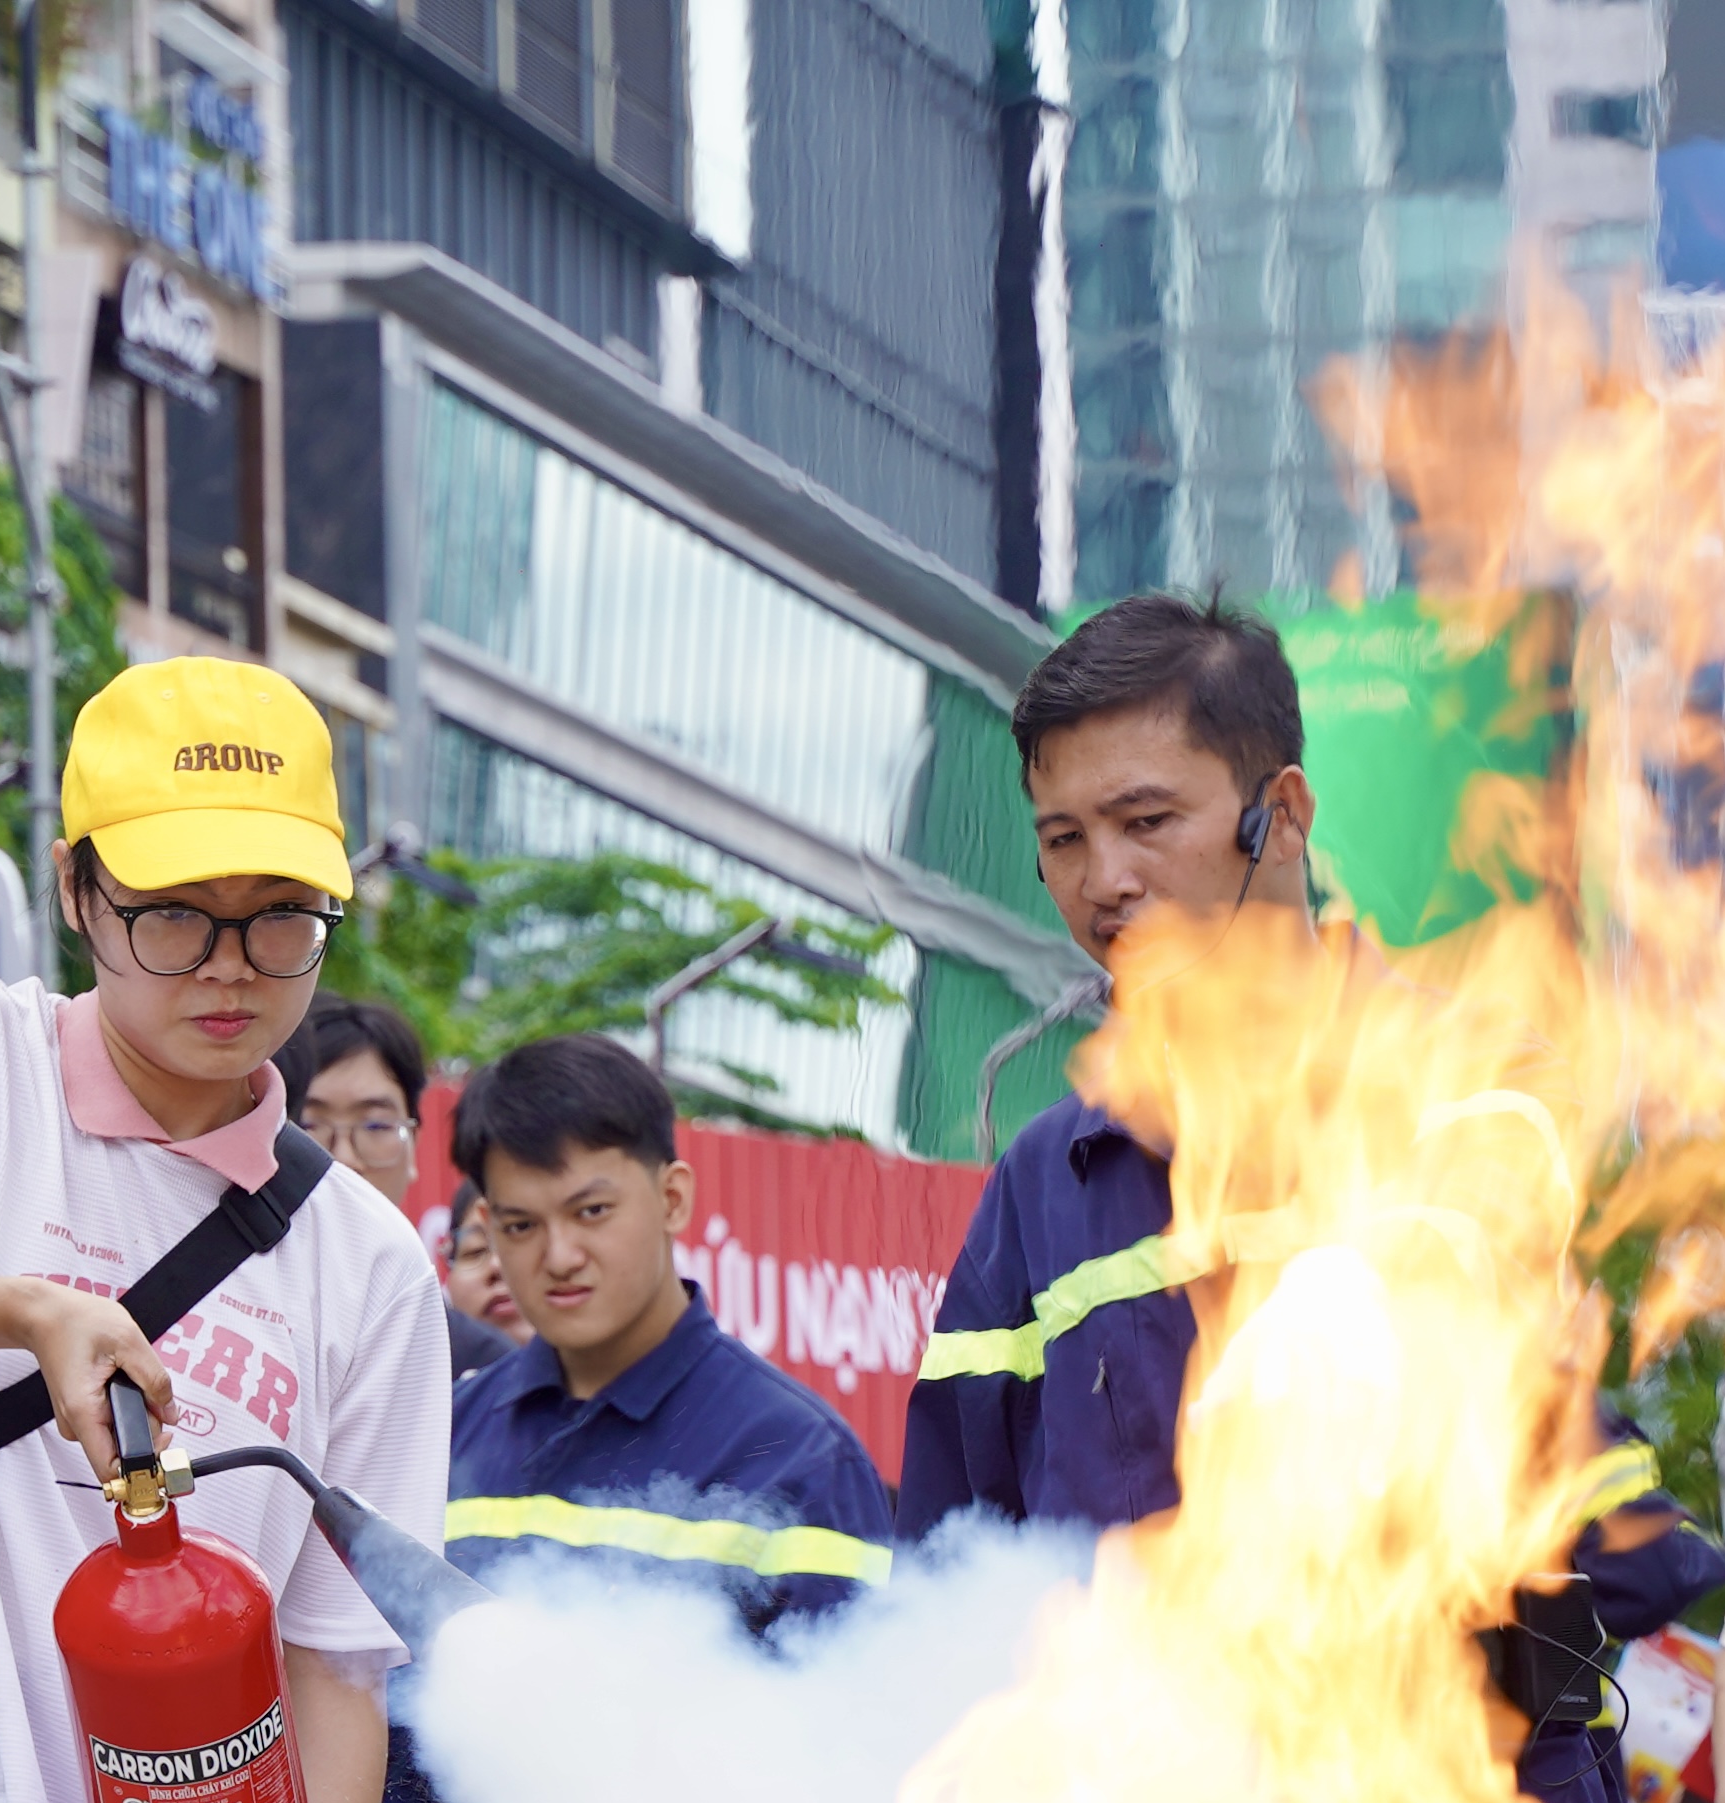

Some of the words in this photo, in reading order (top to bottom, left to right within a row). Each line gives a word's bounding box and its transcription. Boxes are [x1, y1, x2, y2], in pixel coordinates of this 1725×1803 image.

[174, 742, 284, 775] GROUP
[89, 1246, 124, 1264] SCHOOL
[219, 1292, 254, 1317] DESIGN
[93, 1743, 195, 1784] CARBON
[200, 1703, 283, 1778] DIOXIDE
[150, 1788, 172, 1800] BÌNH
[173, 1786, 197, 1799] CHỮA
[197, 1782, 220, 1796] CHÁY
